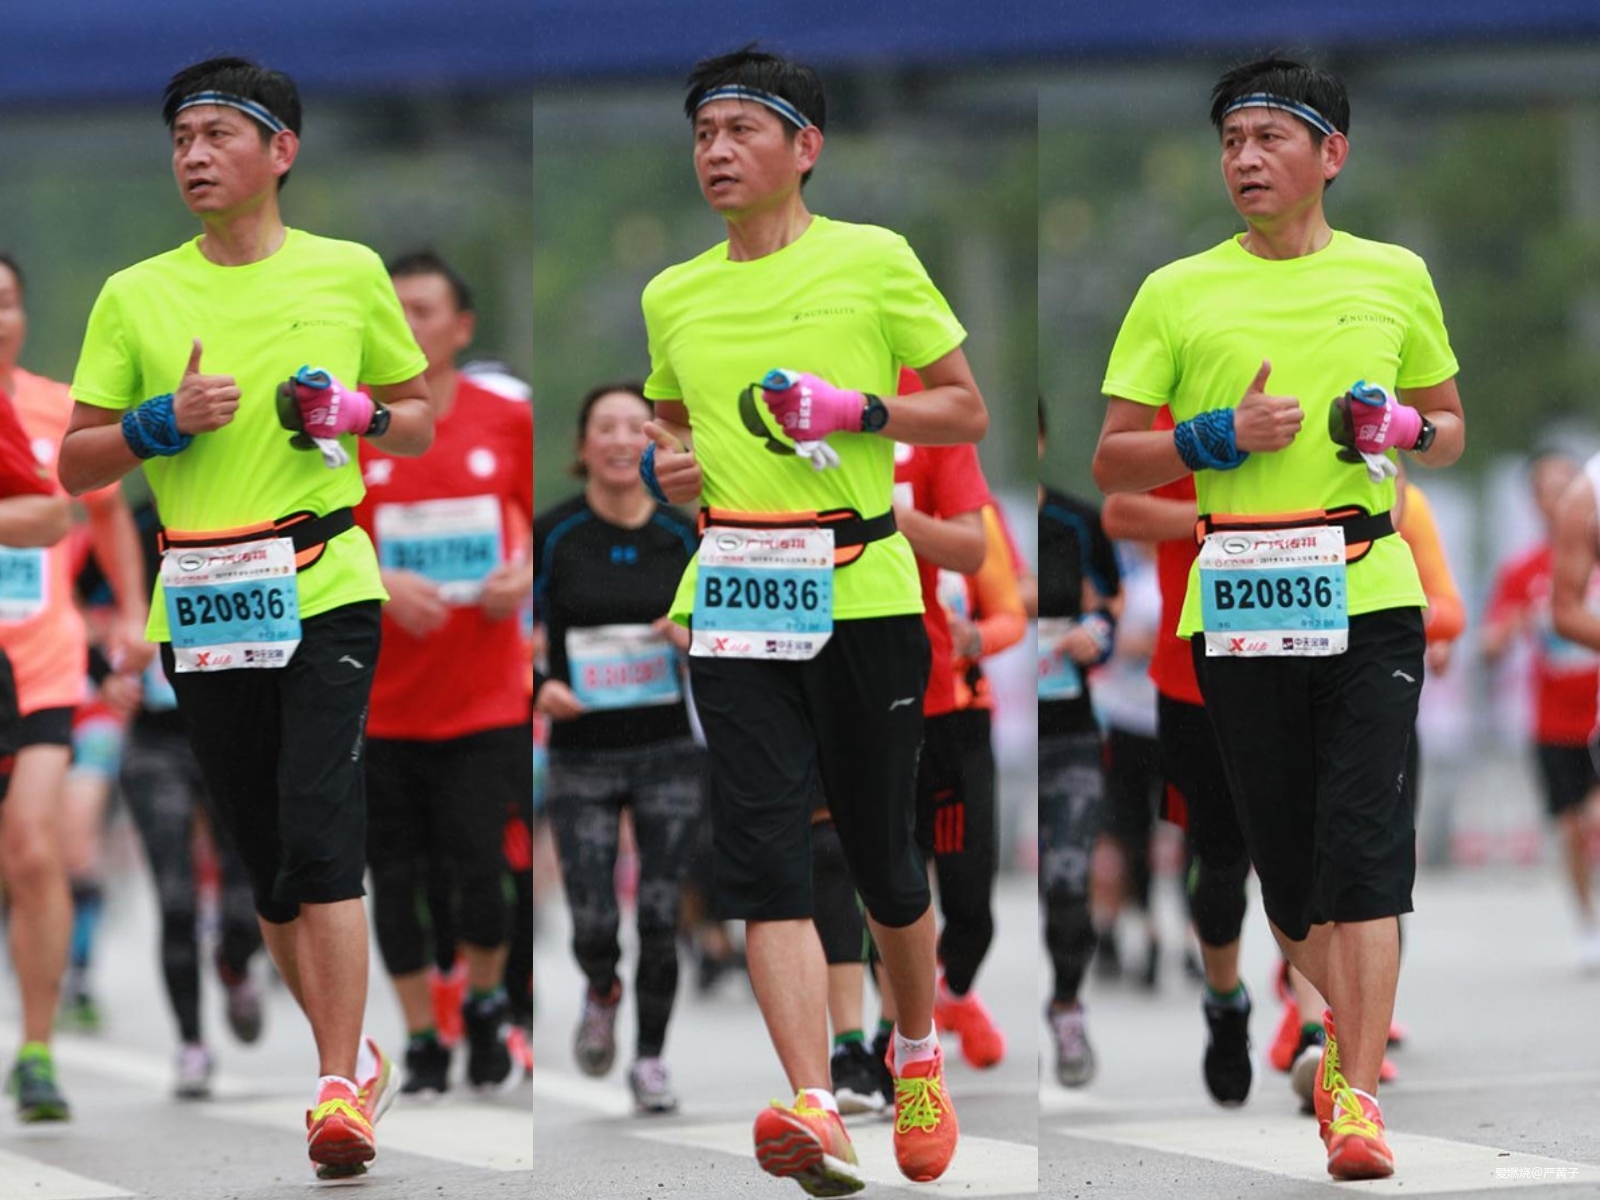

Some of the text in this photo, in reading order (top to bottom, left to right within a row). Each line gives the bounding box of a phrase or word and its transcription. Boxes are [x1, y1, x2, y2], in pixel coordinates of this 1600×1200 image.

[176, 588, 285, 627] B20836
[705, 577, 819, 611] B20836
[1214, 576, 1333, 611] B20836
